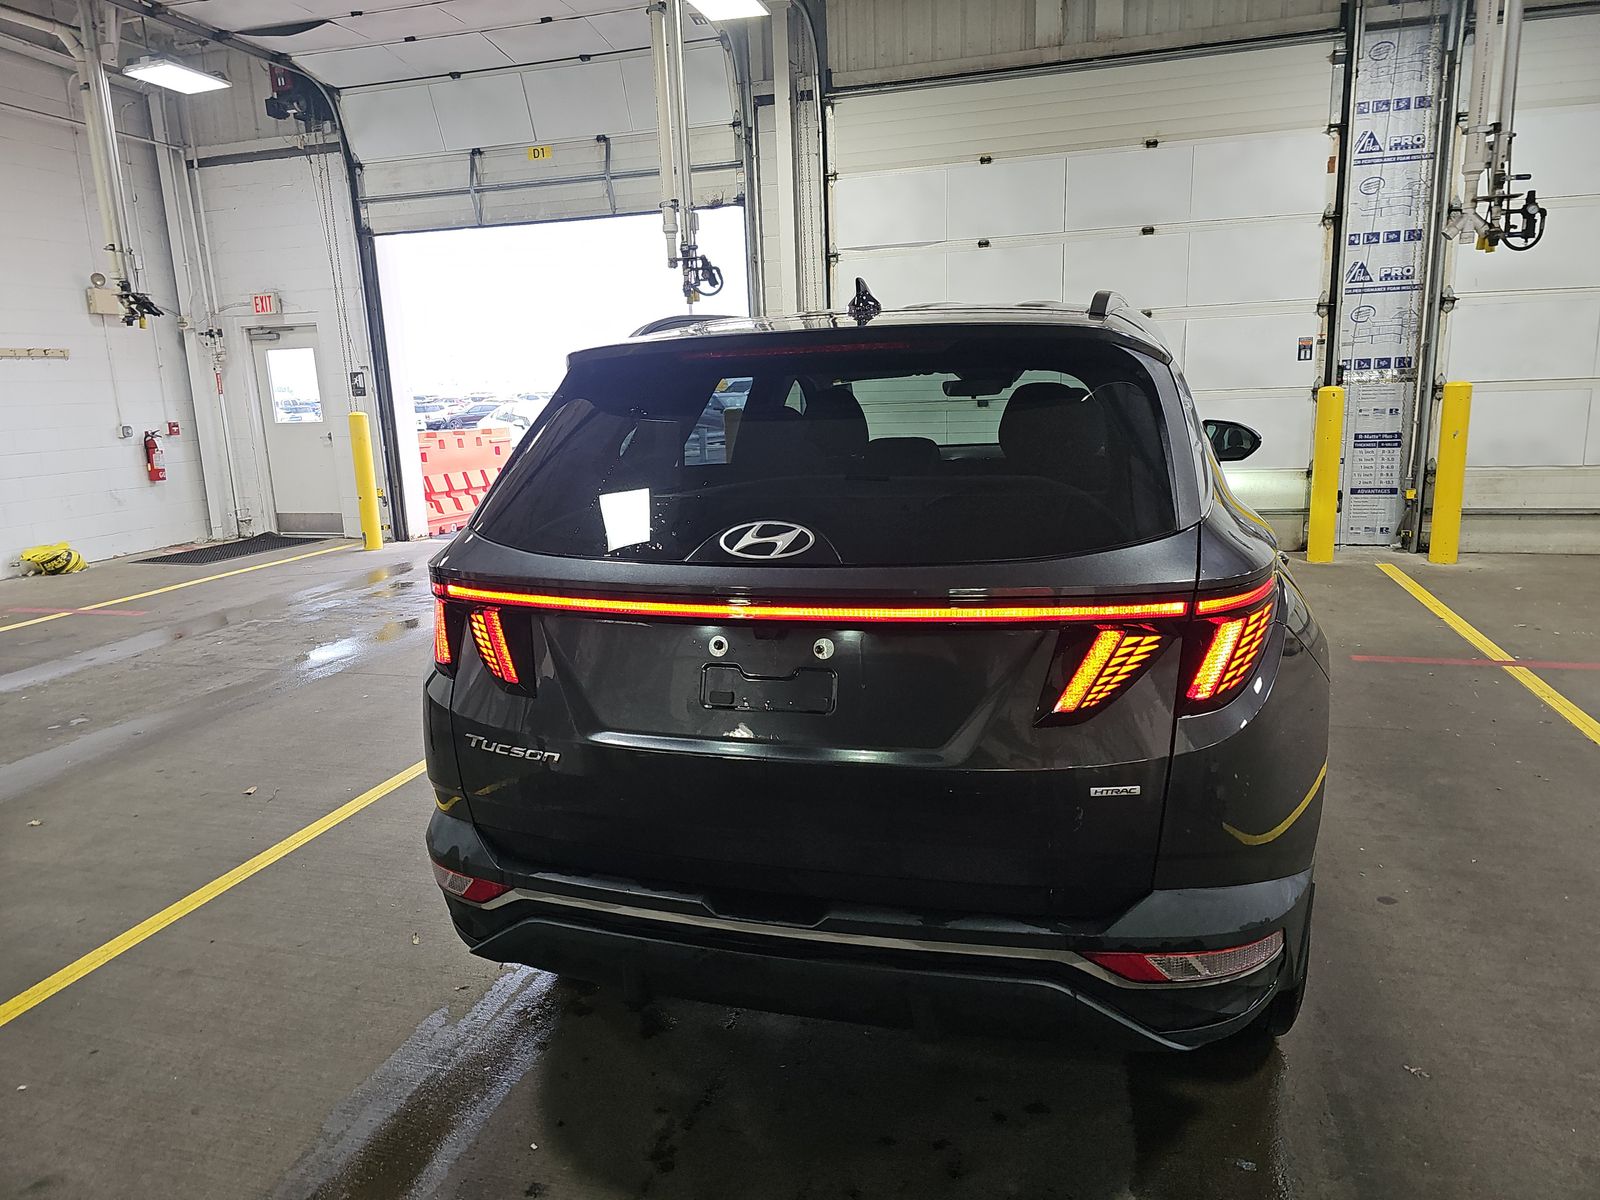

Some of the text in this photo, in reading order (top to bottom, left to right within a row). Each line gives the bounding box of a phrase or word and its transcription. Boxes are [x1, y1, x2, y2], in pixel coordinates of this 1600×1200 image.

[1390, 134, 1425, 146] PRO
[533, 147, 545, 159] D1
[1351, 268, 1370, 281] Sika
[1380, 266, 1414, 277] PRO
[254, 295, 272, 313] EXIT
[1094, 787, 1137, 795] HTRAC
